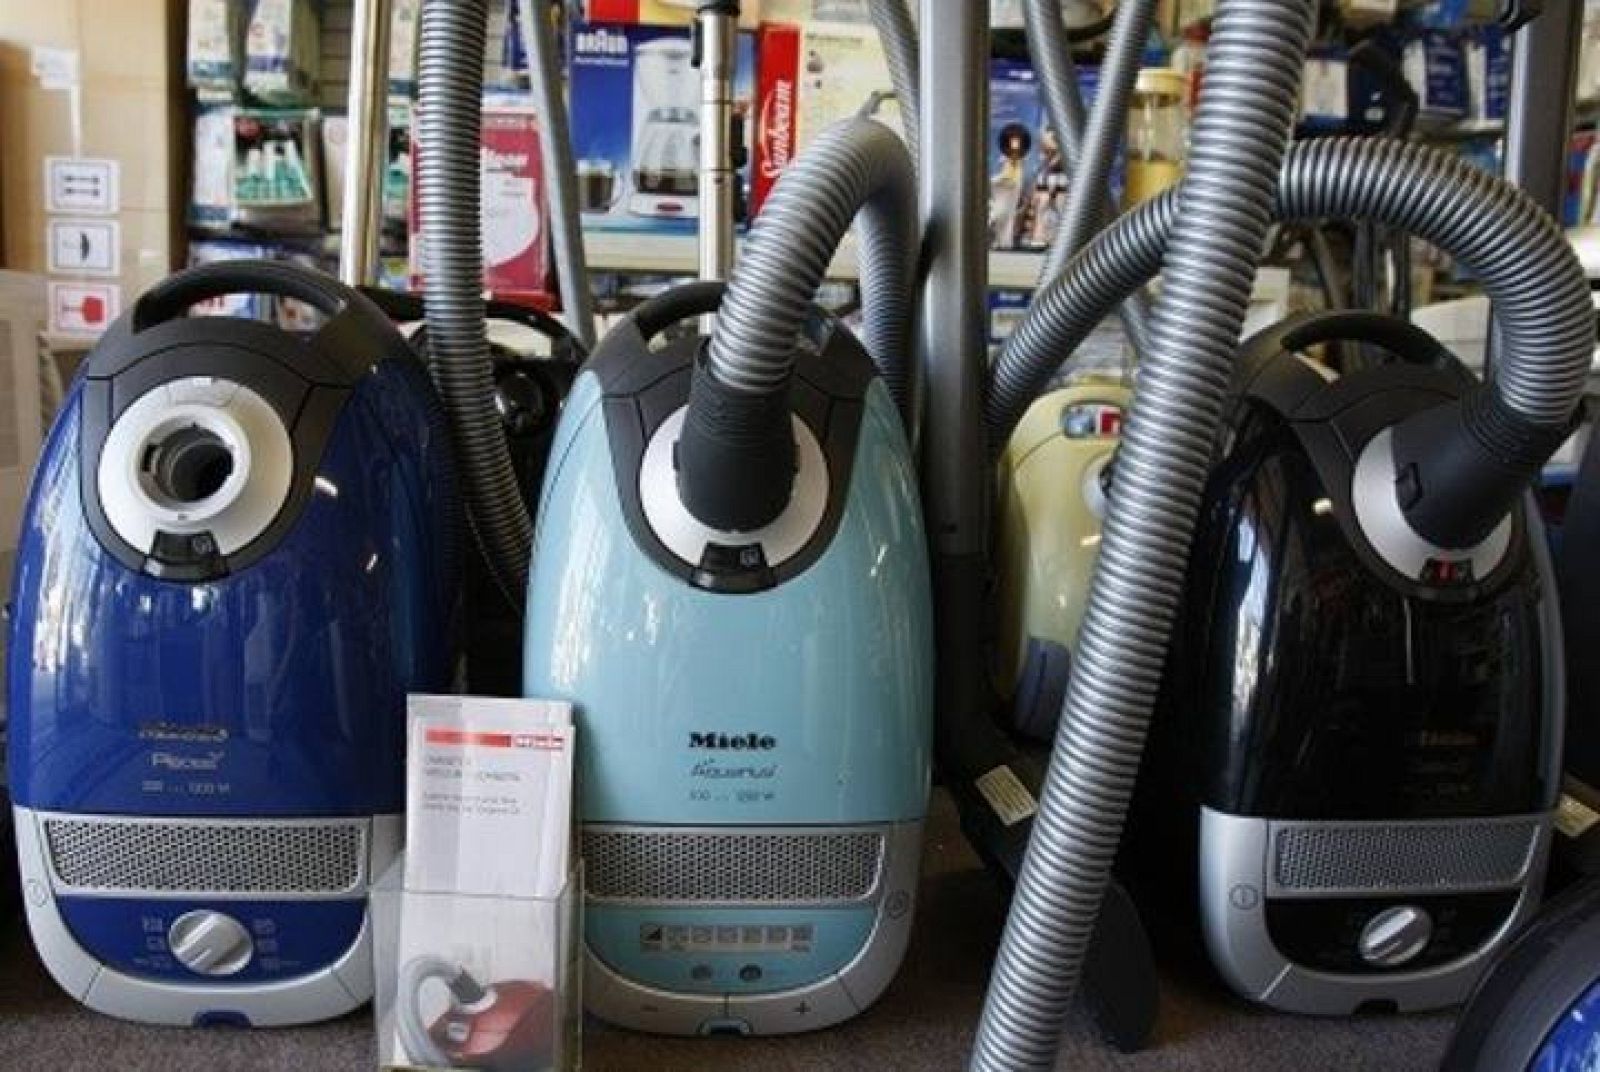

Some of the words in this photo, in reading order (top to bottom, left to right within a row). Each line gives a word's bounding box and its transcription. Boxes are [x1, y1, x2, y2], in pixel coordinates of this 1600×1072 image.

[576, 28, 628, 53] BRAUN
[761, 79, 792, 178] Sunbeam
[688, 731, 777, 751] Miele
